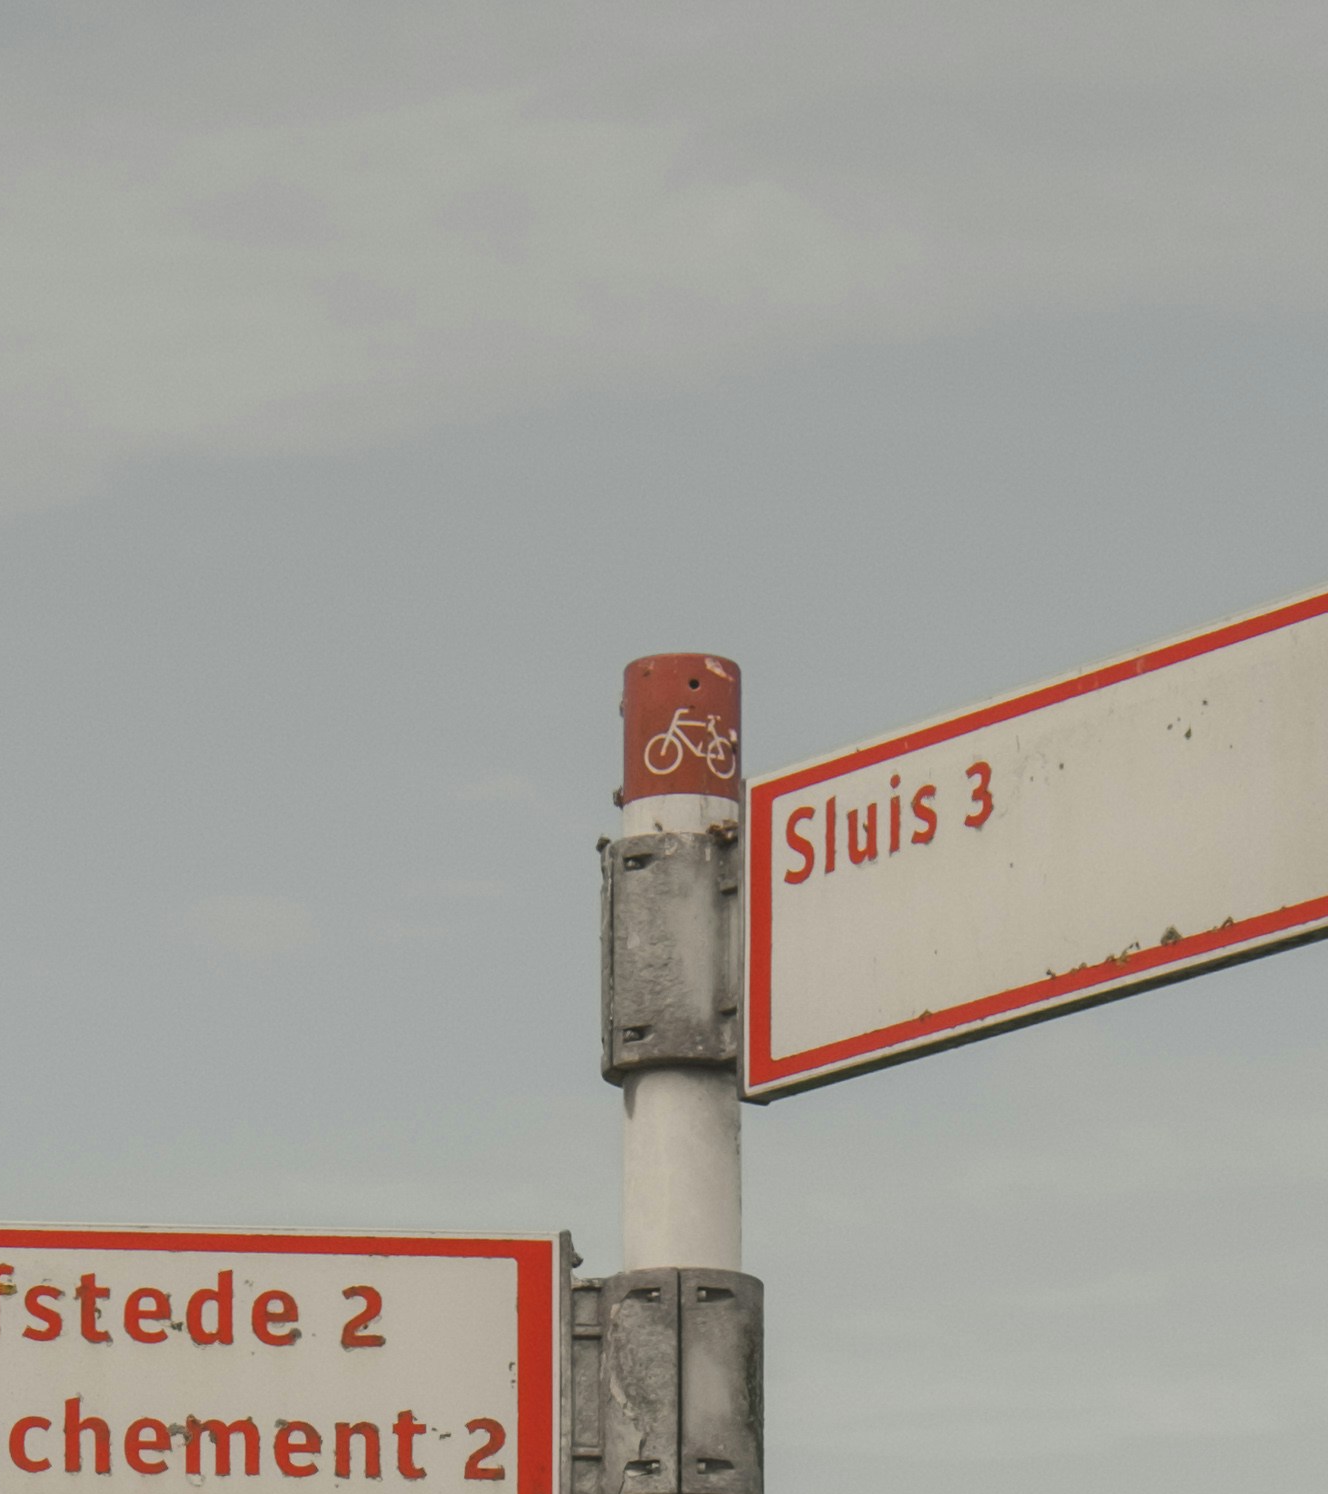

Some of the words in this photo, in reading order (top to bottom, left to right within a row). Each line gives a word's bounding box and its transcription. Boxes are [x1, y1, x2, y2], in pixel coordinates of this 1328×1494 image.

[784, 773, 938, 884] Sluis
[965, 762, 994, 828] 3
[342, 1286, 385, 1348] 2
[465, 1419, 507, 1482] 2
